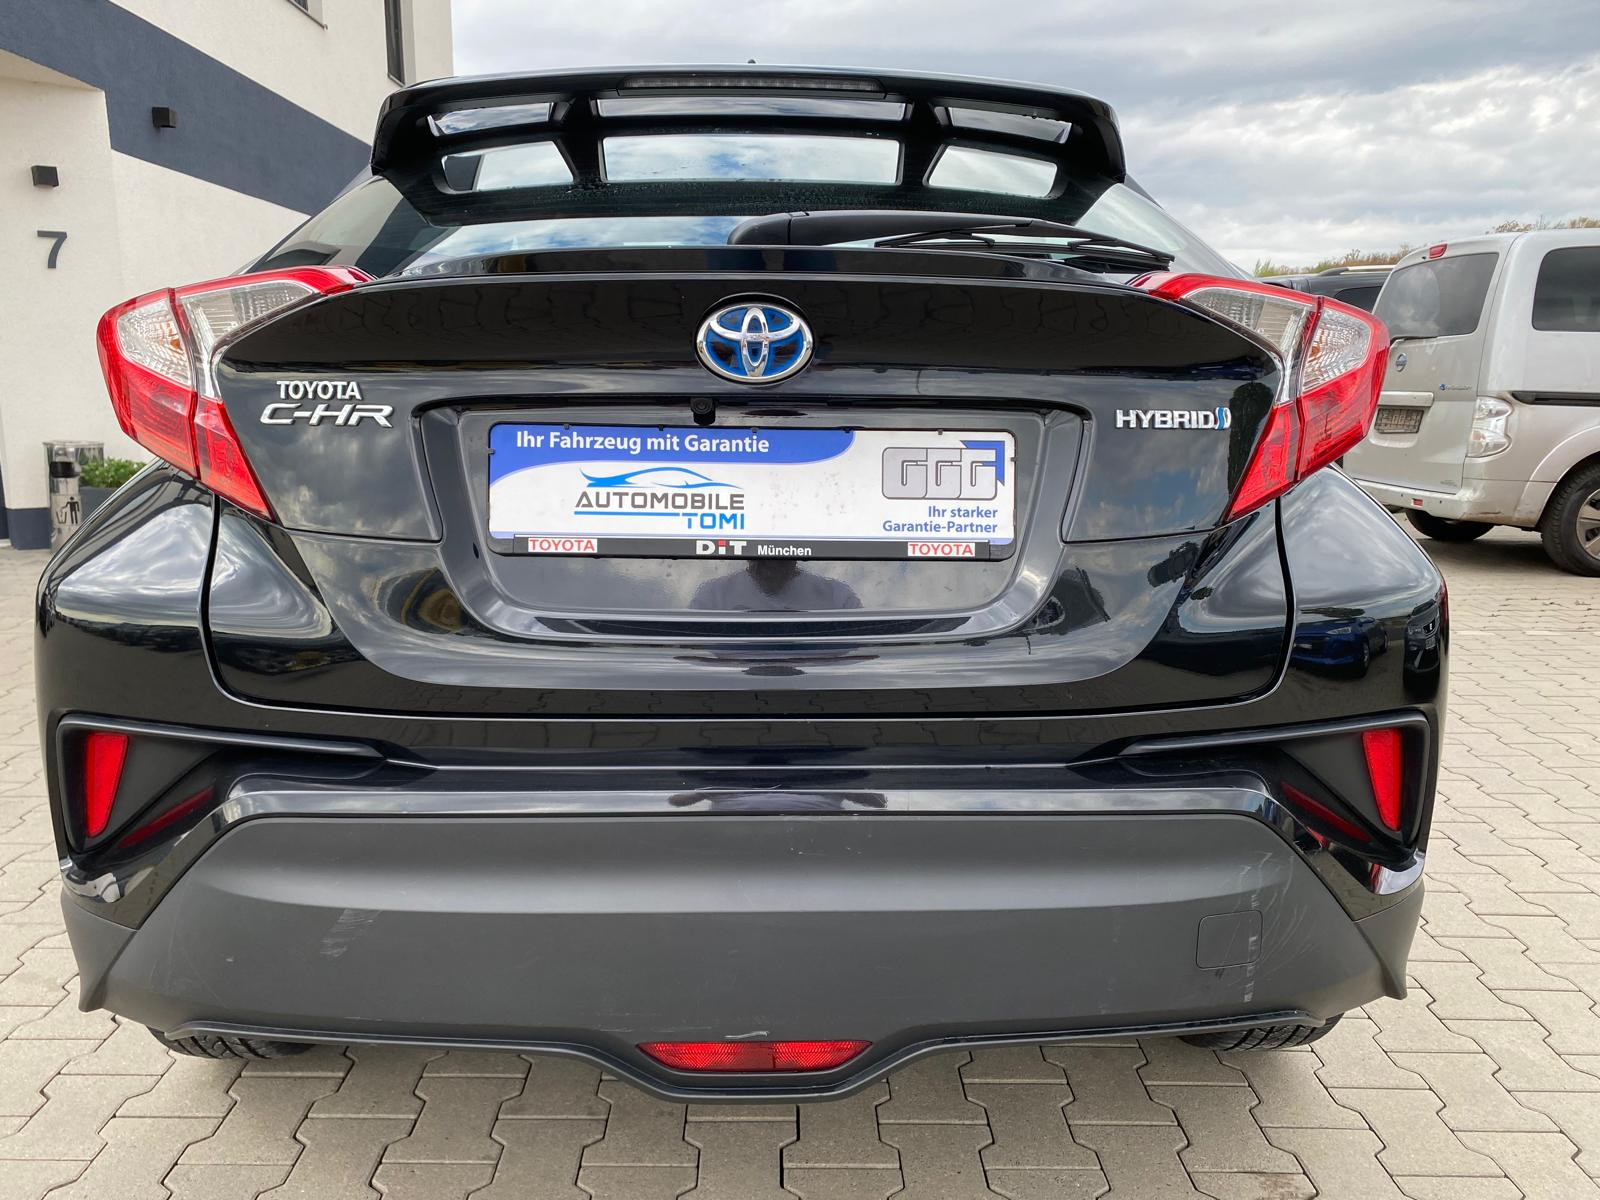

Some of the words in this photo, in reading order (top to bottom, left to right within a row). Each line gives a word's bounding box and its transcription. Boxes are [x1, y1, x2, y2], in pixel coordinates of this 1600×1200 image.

[37, 230, 68, 269] 7
[276, 381, 362, 400] TOYOTA
[260, 403, 394, 428] C-HR
[1116, 409, 1216, 429] HYBRID
[516, 431, 544, 448] Ihr
[549, 432, 641, 455] Fahrzeug
[647, 434, 680, 451] mit
[684, 435, 769, 453] Garantie
[575, 491, 745, 510] AUTOMOBILE
[682, 512, 745, 529] TOMI
[928, 506, 947, 518] Ihr
[950, 506, 998, 518] starker
[883, 520, 998, 533] Garantie-Partner
[529, 539, 595, 552] TOYOTA
[757, 544, 812, 556] München
[909, 543, 974, 556] TOYOTA
